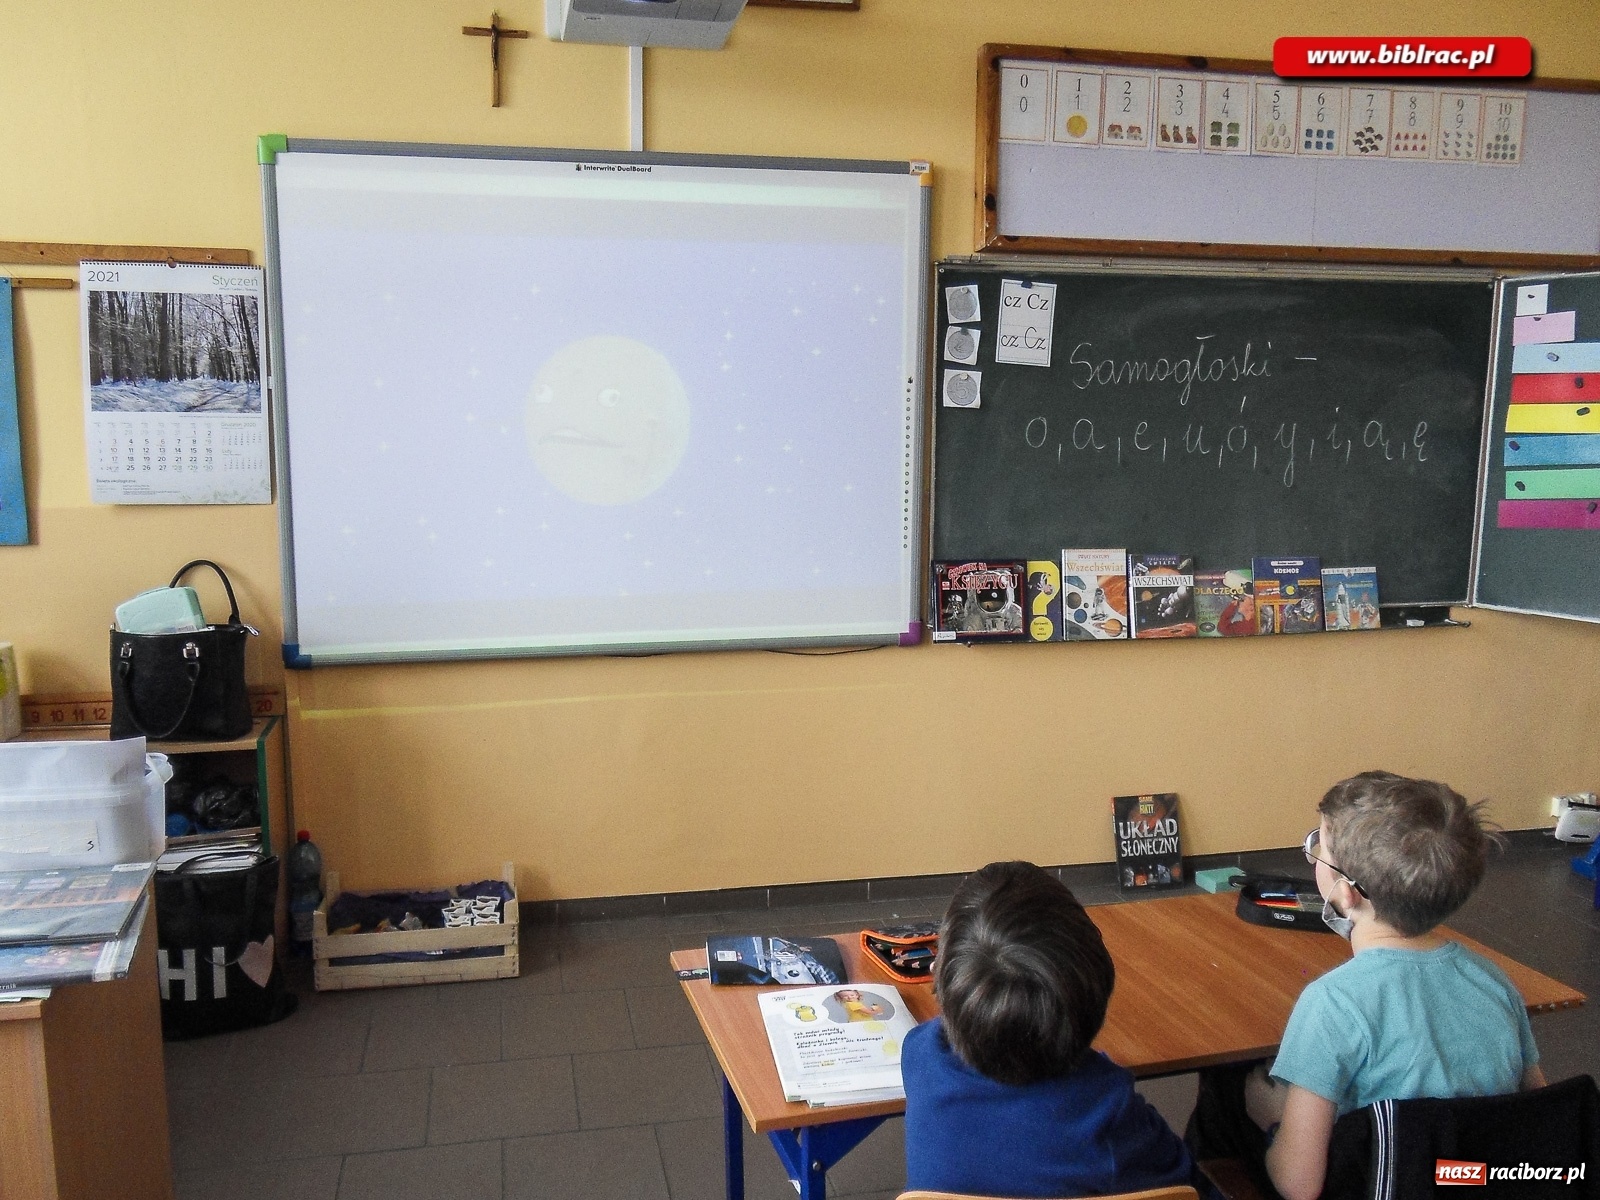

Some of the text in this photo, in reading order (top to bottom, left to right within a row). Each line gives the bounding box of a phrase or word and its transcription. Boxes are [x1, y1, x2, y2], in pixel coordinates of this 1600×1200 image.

[1020, 74, 1028, 88] 0
[1076, 78, 1081, 92] 1
[1124, 81, 1131, 94] 2
[1176, 84, 1184, 98] 3
[1223, 88, 1230, 100] 4
[1273, 90, 1280, 104] 5
[1019, 96, 1028, 112] 0
[1075, 95, 1080, 109] 1
[1123, 96, 1131, 113] 2
[1318, 92, 1325, 105] 6
[1366, 95, 1374, 107] 7
[1410, 97, 1417, 109] 8
[1457, 99, 1464, 112] 9
[1175, 100, 1183, 115] 3
[1222, 103, 1229, 117] 4
[1273, 106, 1280, 120] 5
[1500, 103, 1512, 115] 10
[1317, 108, 1324, 122] 6
[1366, 110, 1374, 124] 7
[1409, 113, 1416, 126] 8
[1456, 114, 1463, 128] 9
[1498, 118, 1510, 132] 10
[88, 271, 120, 282] 2021
[212, 274, 258, 287] Styczeń
[1004, 294, 1048, 310] cz Cz
[1001, 327, 1046, 350] cz Cz
[1070, 334, 1272, 406] Samogłoski
[1067, 562, 1124, 572] Wszechświat
[31, 700, 272, 723] 9 10 11 12 20
[1119, 818, 1178, 839] UKŁAD
[1121, 836, 1178, 857] SŁONECZNY
[158, 946, 226, 1001] HI
